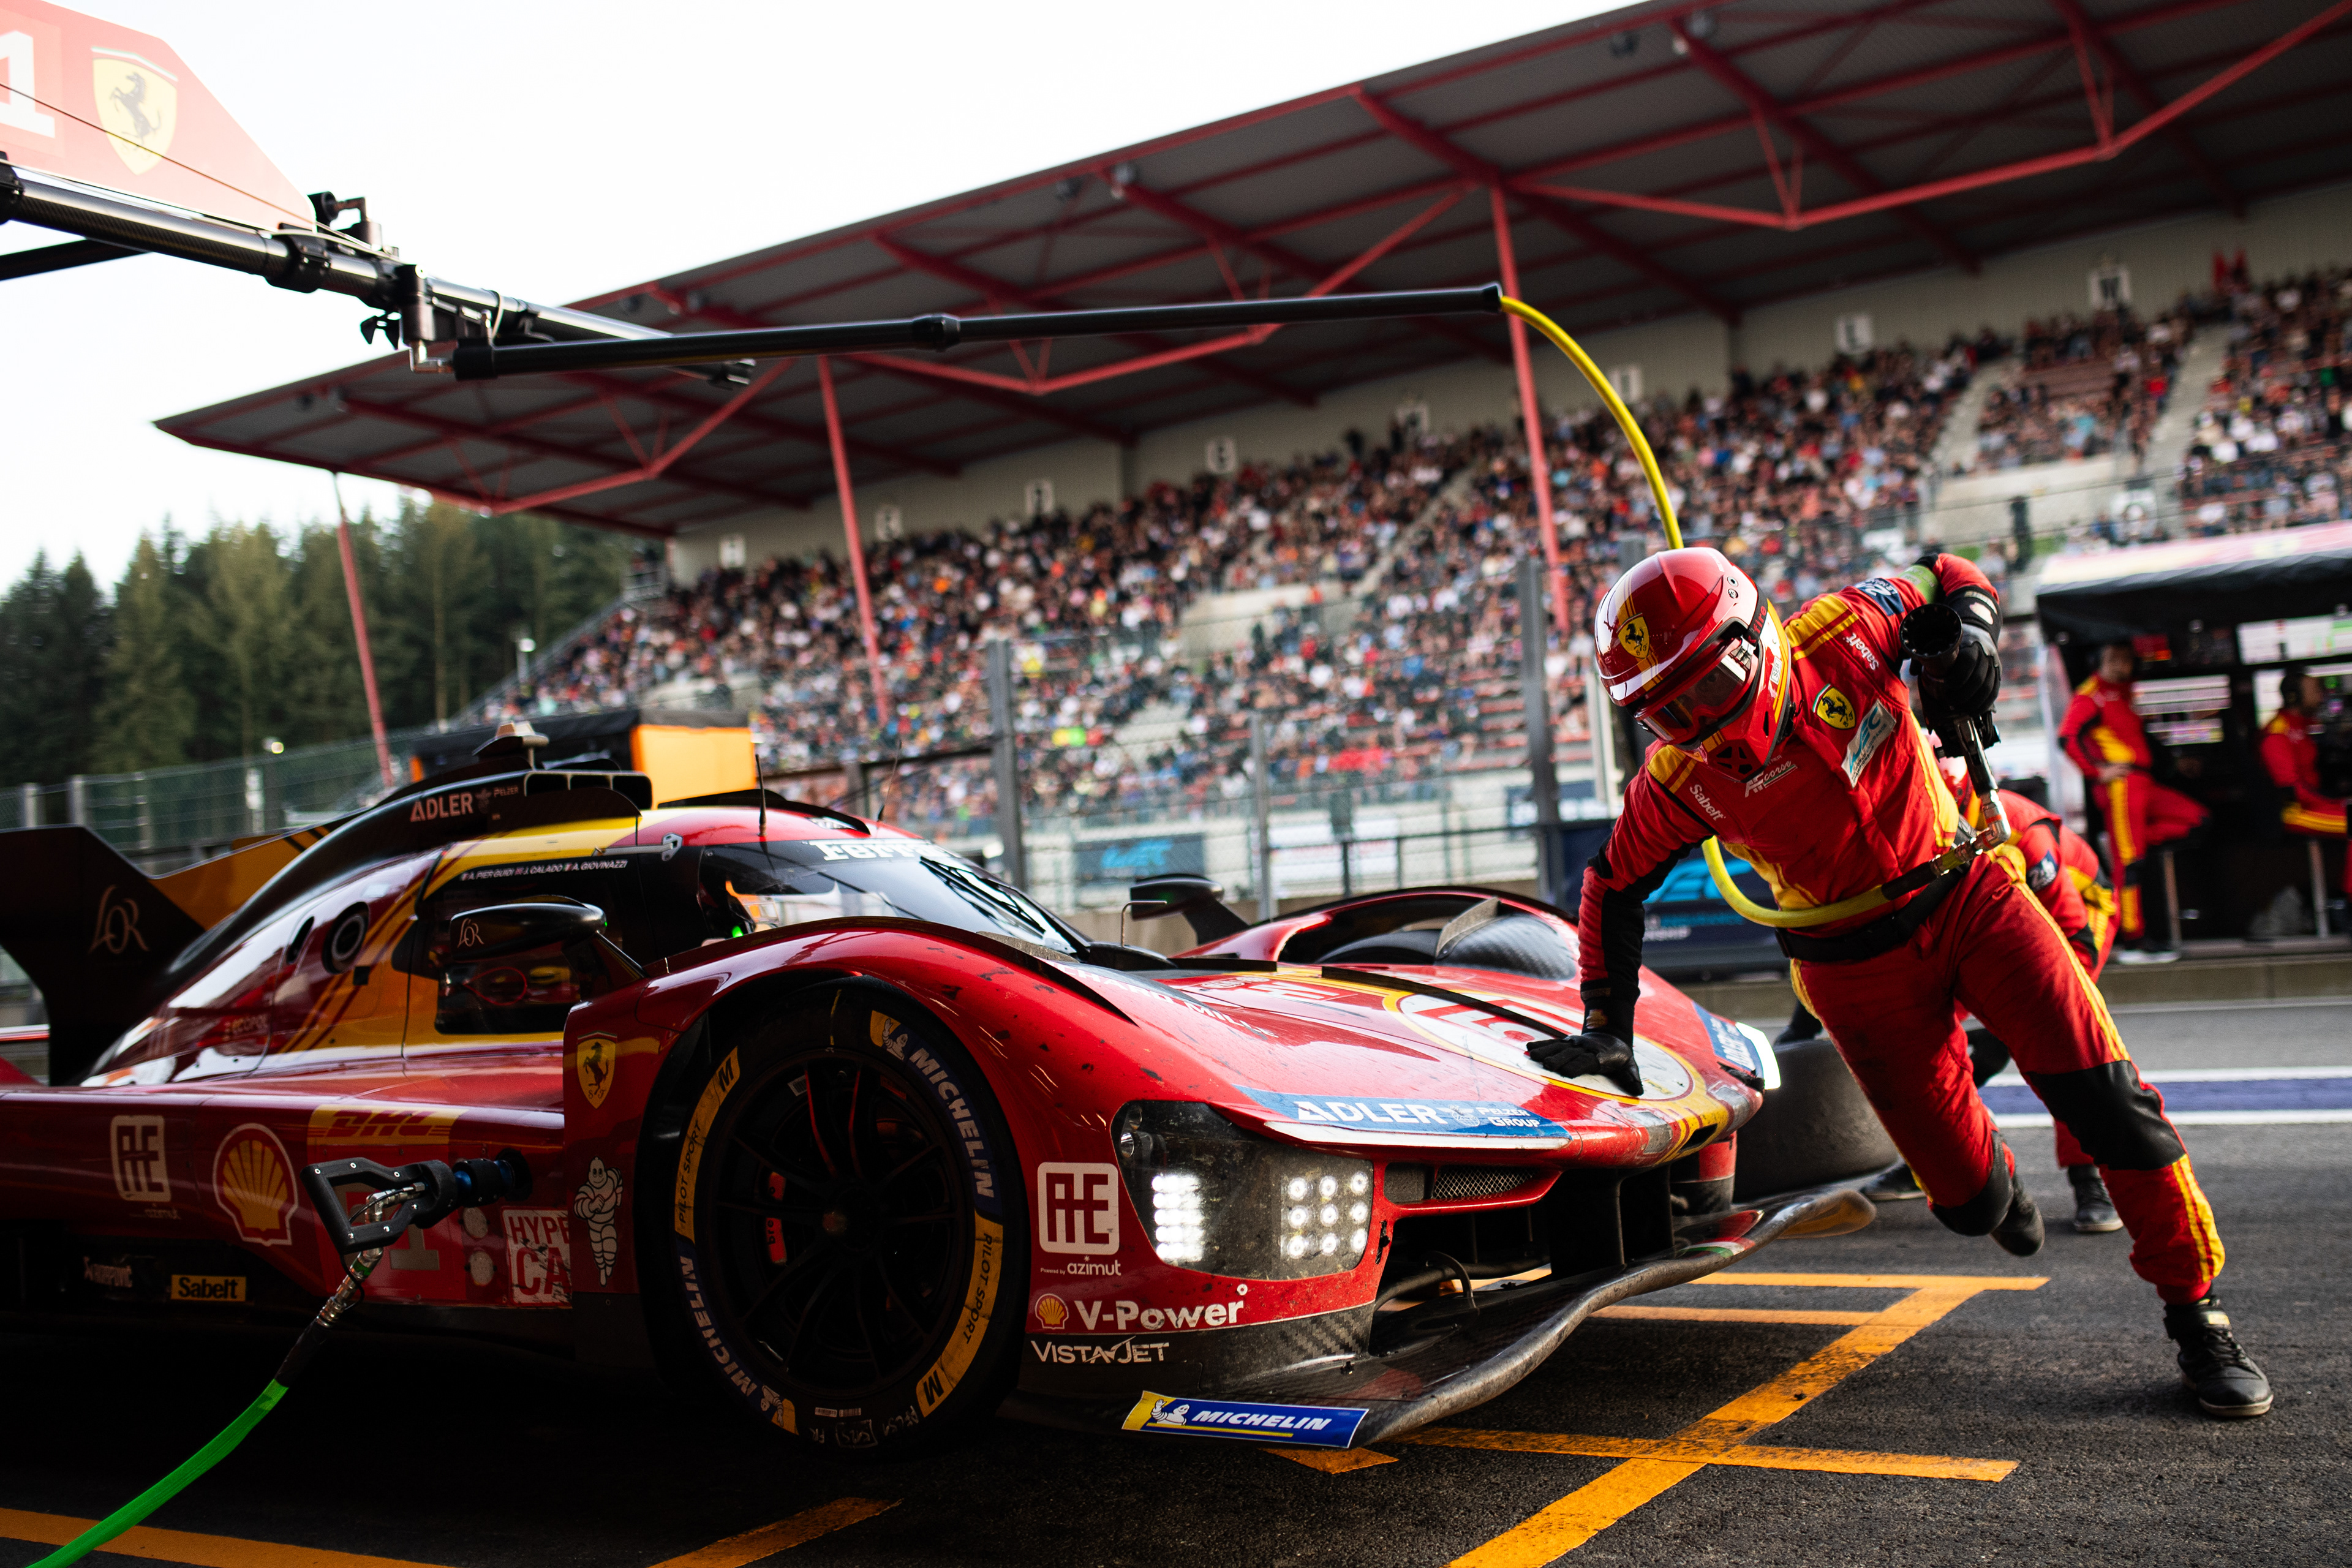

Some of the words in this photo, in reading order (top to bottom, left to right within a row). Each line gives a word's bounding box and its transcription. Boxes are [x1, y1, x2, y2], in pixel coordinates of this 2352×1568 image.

[1843, 632, 1879, 671] Sabelt
[1764, 761, 1792, 782] corse
[493, 785, 519, 797] PELZER
[1689, 784, 1726, 821] Sabelt
[410, 791, 473, 823] ADLER
[476, 870, 492, 880] PIER
[494, 869, 514, 878] GUIDI
[530, 864, 563, 875] CALADO
[581, 860, 628, 870] GIOVINAZZI
[909, 1047, 995, 1199] MICHELIN
[1294, 1101, 1448, 1124] ADLER
[1475, 1107, 1531, 1117] PELZER
[1487, 1116, 1540, 1128] GROUP
[679, 1175, 689, 1224] PILOT
[684, 1120, 701, 1175] SPORT
[766, 1186, 776, 1245] breo
[980, 1232, 993, 1286] PILOT
[1067, 1256, 1121, 1276] azimut
[178, 1276, 238, 1299] Sabelt
[680, 1256, 758, 1397] MICHELIN
[965, 1287, 986, 1344] SPORT
[1074, 1300, 1244, 1330] V-Power
[1030, 1335, 1169, 1363] VISTAJET
[1191, 1410, 1333, 1431] MICHELIN
